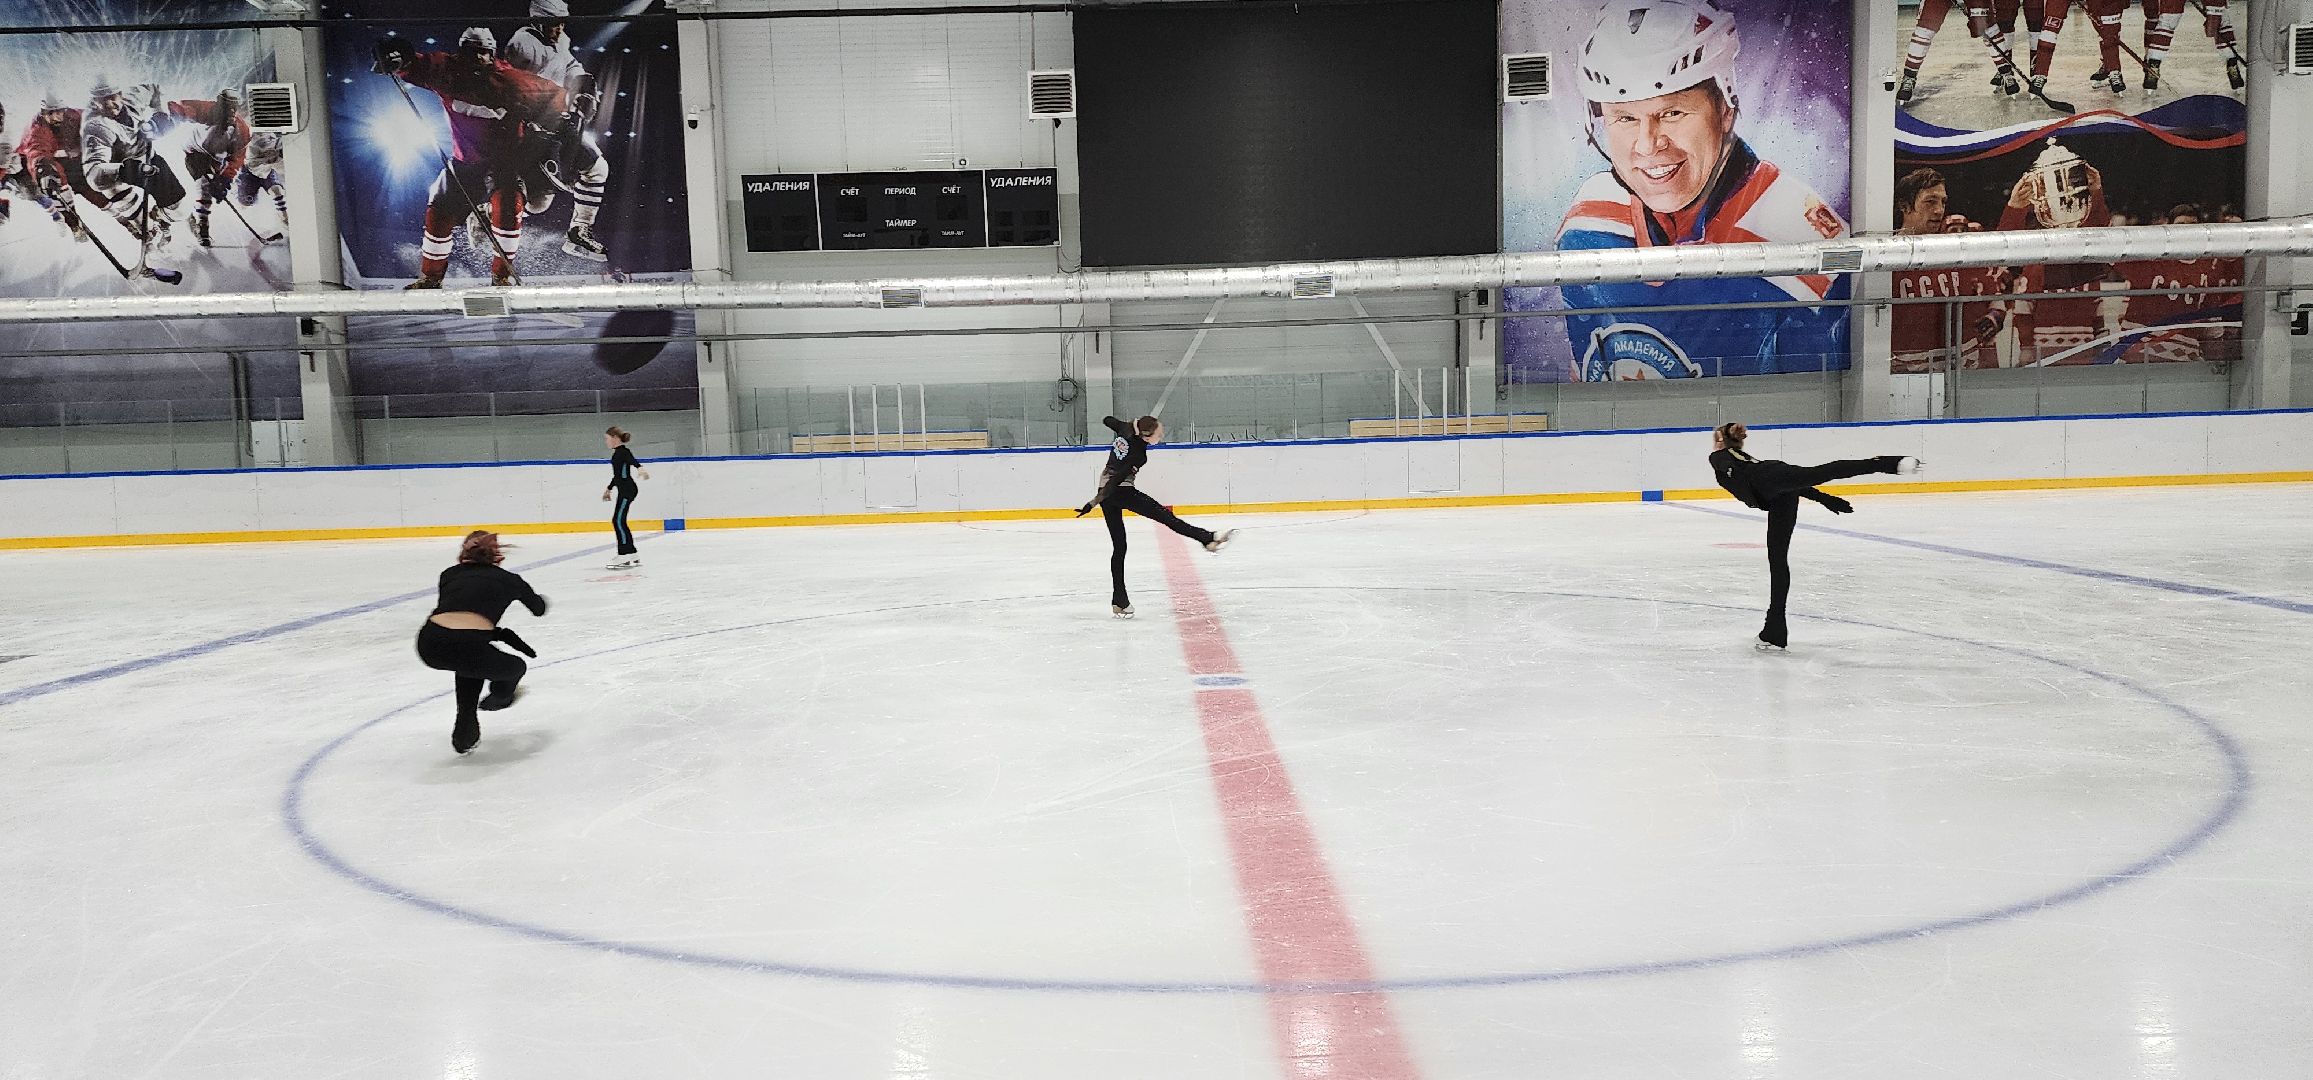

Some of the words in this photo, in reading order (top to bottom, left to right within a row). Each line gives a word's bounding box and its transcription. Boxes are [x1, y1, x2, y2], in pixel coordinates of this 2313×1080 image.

[990, 176, 1052, 188] УДАЛЕНИЯ
[747, 182, 810, 193] УДАЛЕНИЯ
[840, 187, 860, 196] СЧЁТ
[884, 187, 917, 196] ПЕРИОД
[942, 184, 961, 194] СЧЁТ
[885, 218, 917, 227] ТАЙМЕР
[1899, 271, 1960, 298] СССР
[1613, 340, 1676, 372] АКАДЕМИЯ
